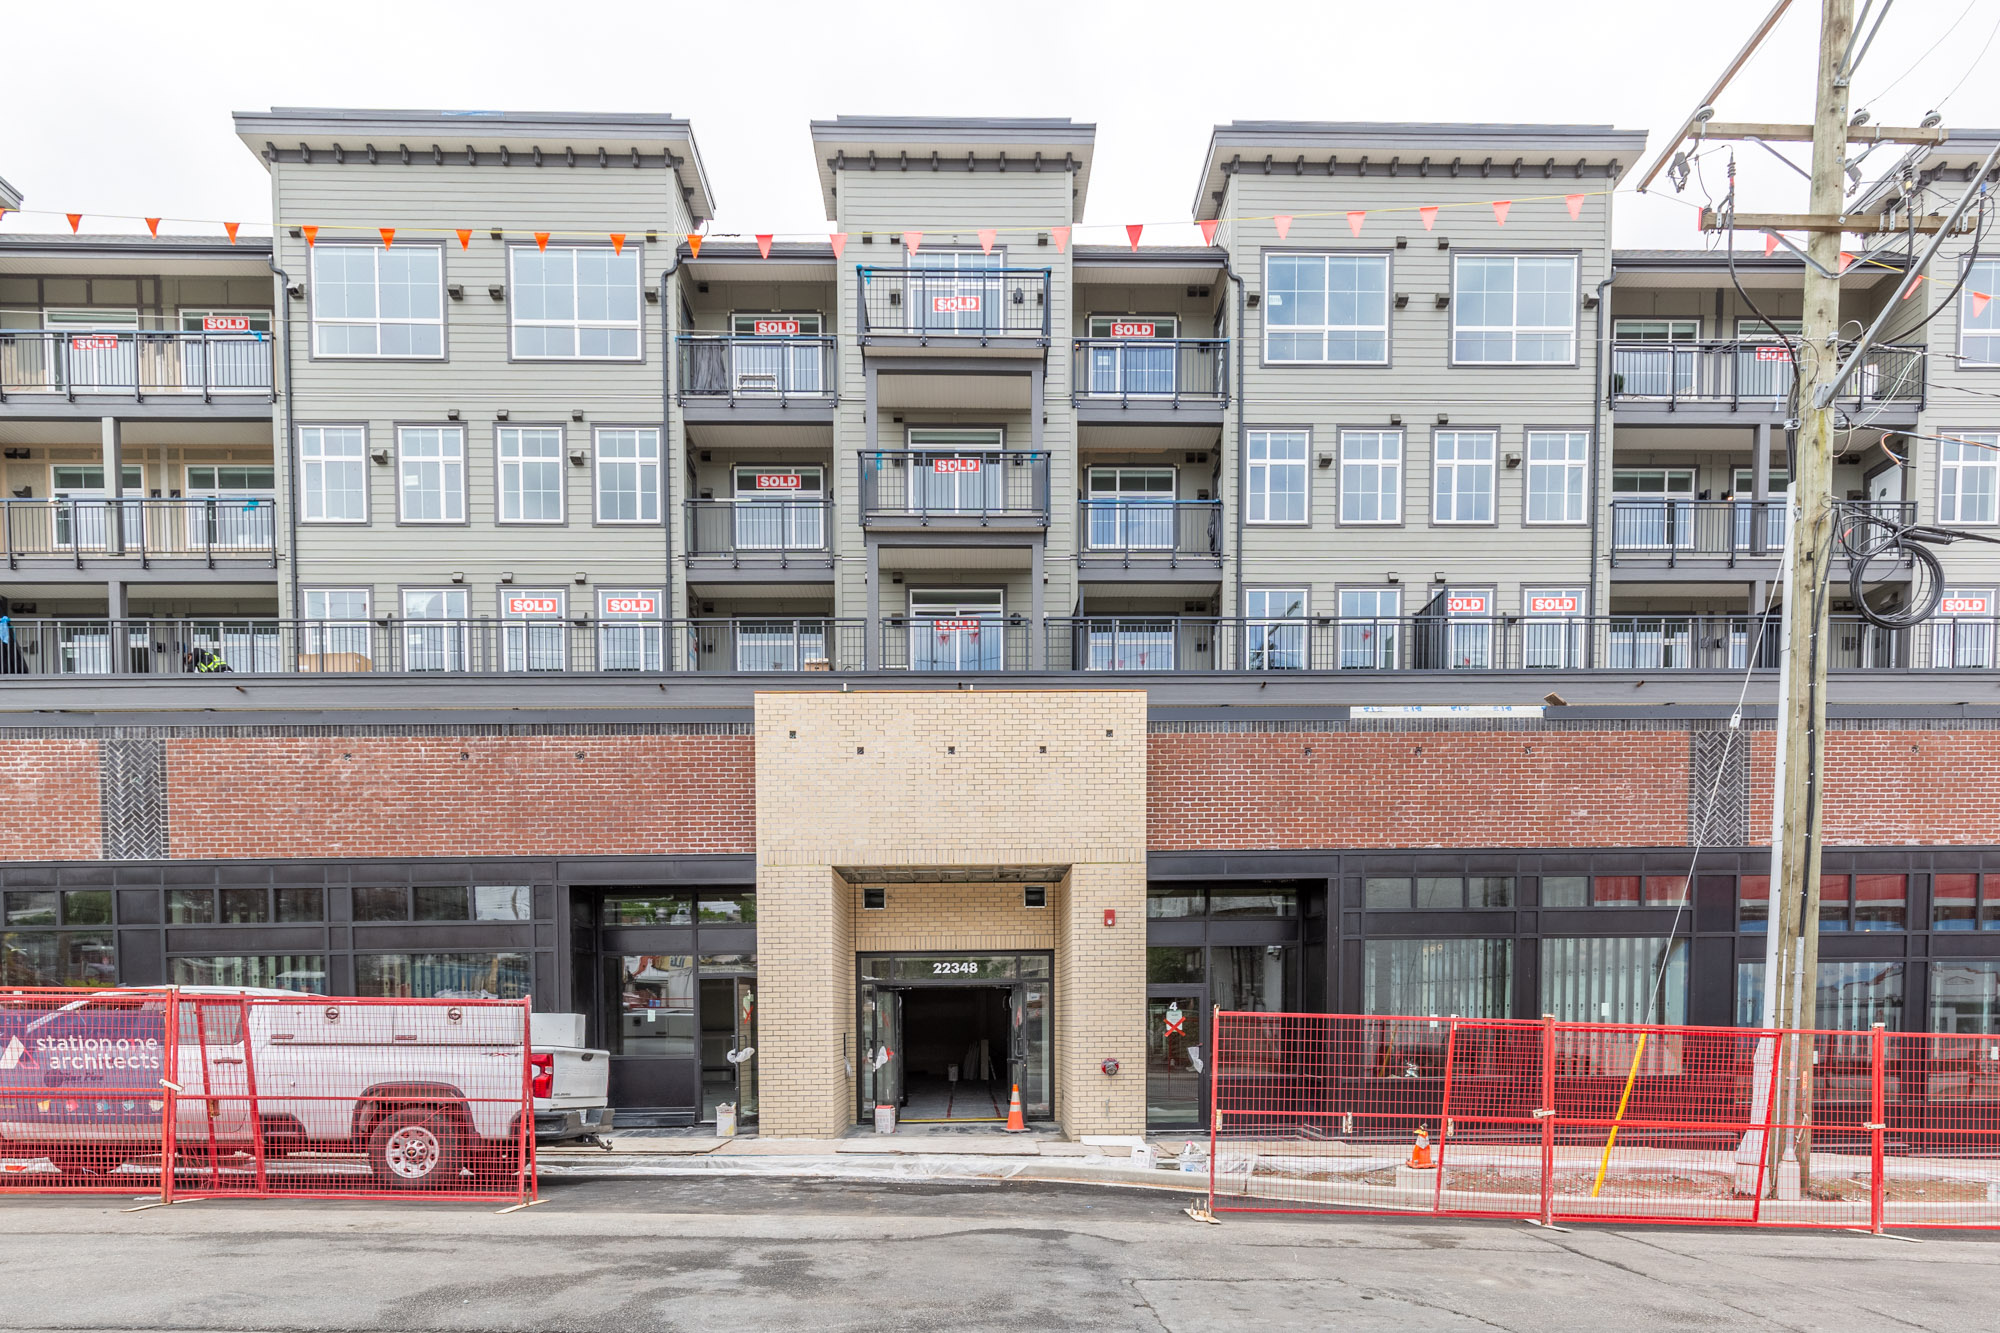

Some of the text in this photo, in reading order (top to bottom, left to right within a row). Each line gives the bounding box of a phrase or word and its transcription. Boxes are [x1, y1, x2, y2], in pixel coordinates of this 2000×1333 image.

[937, 297, 976, 311] SOLD
[207, 318, 246, 329] SOLD
[758, 322, 796, 333] SOLD
[1114, 324, 1152, 335] SOLD
[937, 459, 977, 471] SOLD
[760, 476, 798, 487] SOLD
[513, 600, 554, 612] SOLD
[610, 600, 650, 612] SOLD
[1535, 599, 1573, 610] SOLD
[1945, 600, 1982, 611] SOLD
[938, 619, 978, 630] SOLD
[932, 962, 978, 974] 22348
[1169, 1001, 1178, 1011] 4
[36, 1034, 158, 1051] station one
[49, 1052, 160, 1069] architects
